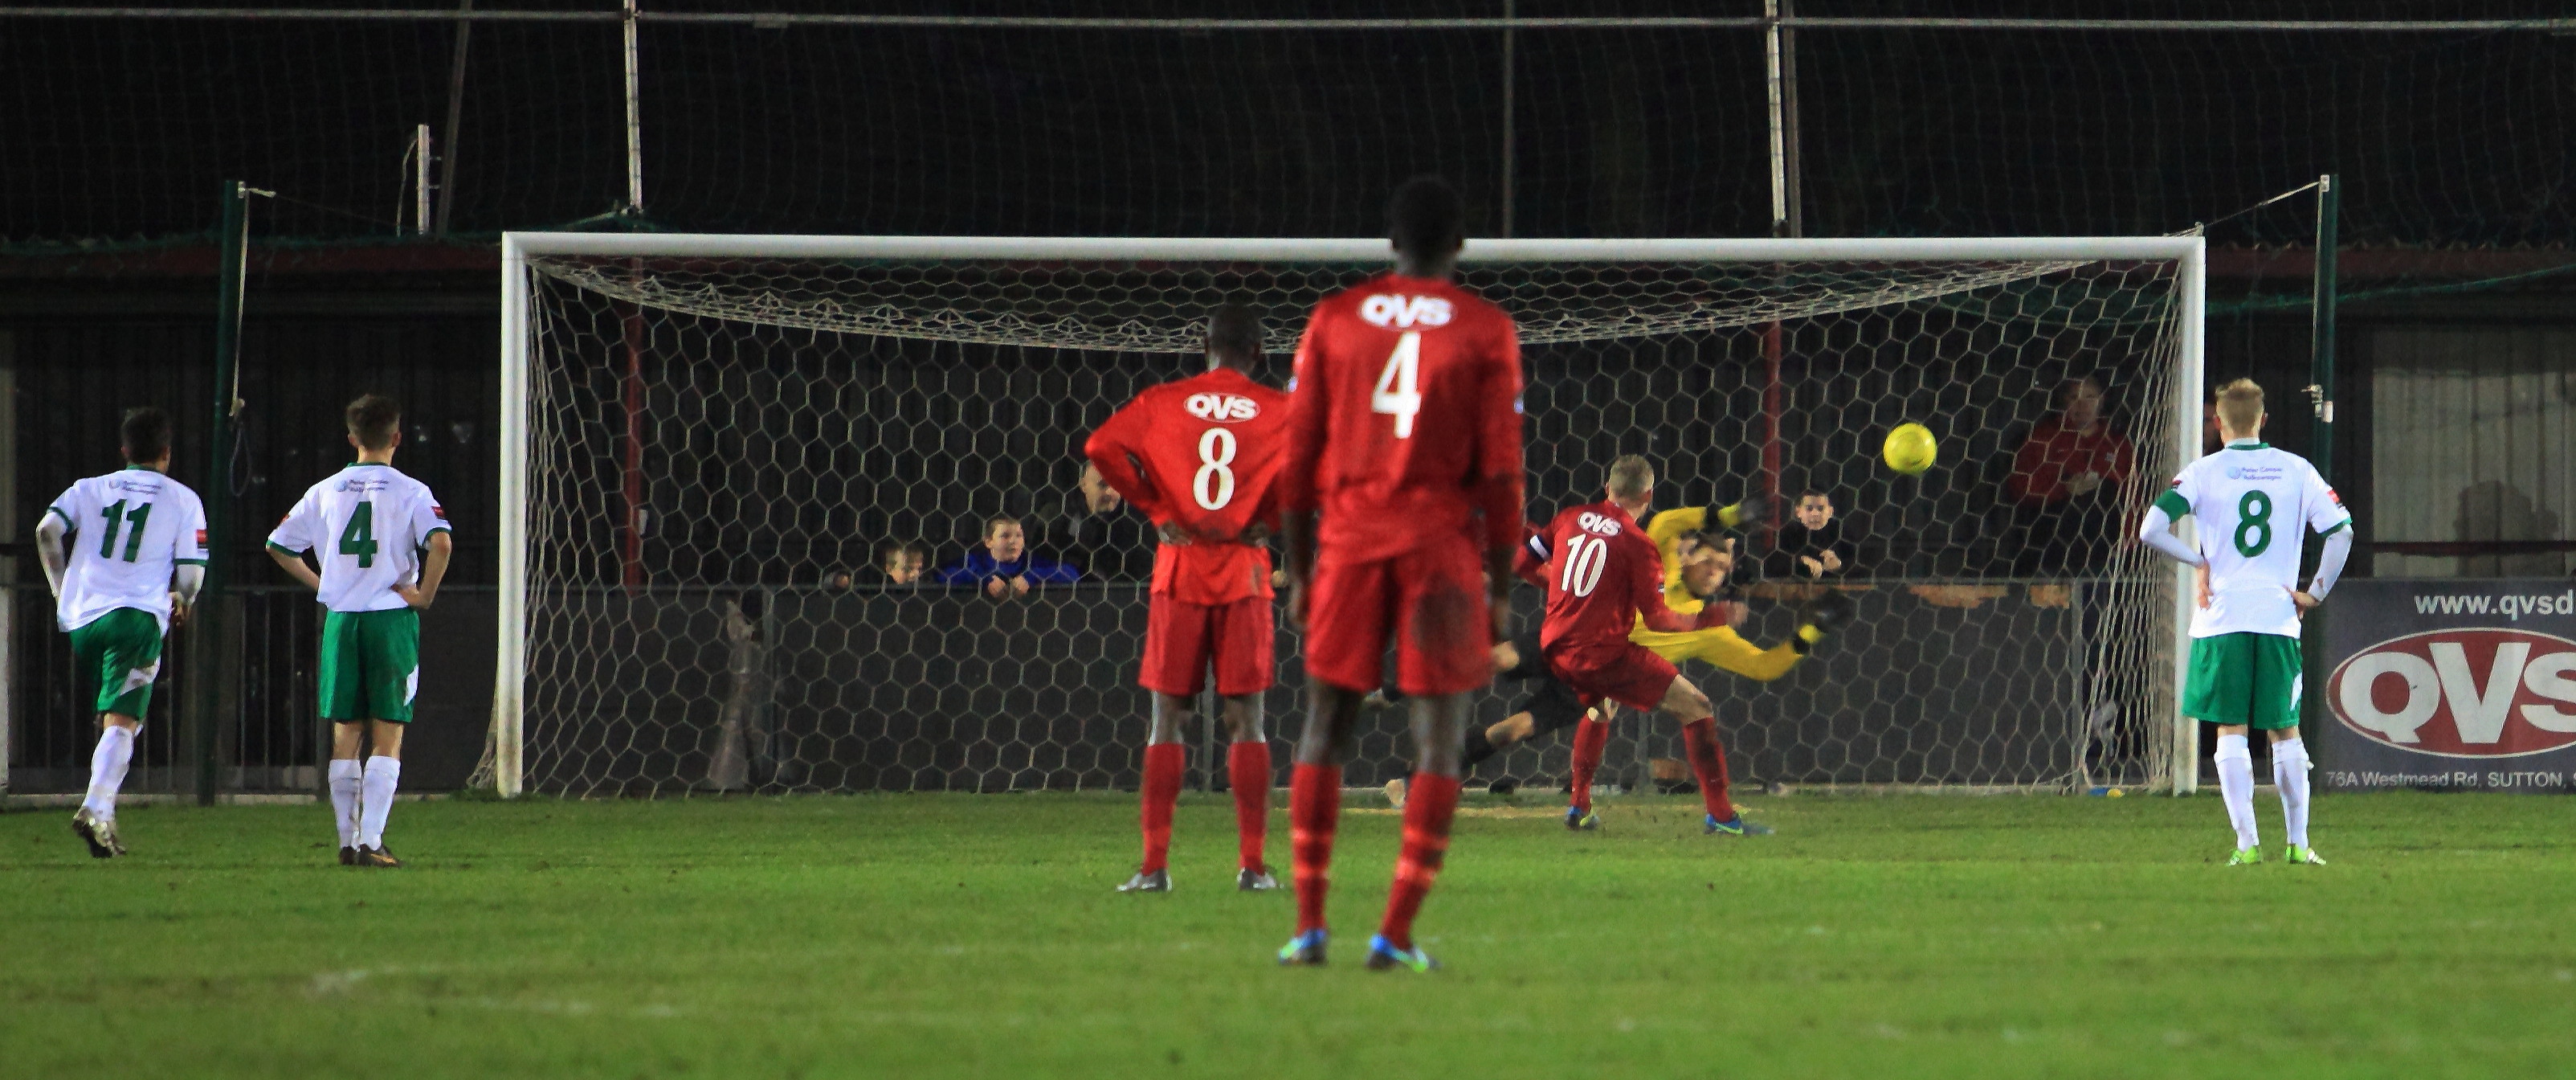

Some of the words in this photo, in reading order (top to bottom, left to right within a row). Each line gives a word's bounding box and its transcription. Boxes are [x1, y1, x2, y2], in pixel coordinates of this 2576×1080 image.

[1361, 293, 1453, 328] QVS
[1186, 393, 1257, 420] QVS
[1371, 331, 1423, 439] 4
[1193, 427, 1237, 510] 8
[100, 498, 152, 562] 11
[339, 501, 378, 568] 4
[1578, 511, 1623, 537] QVS
[2235, 489, 2272, 558] 8
[1561, 534, 1607, 597] 10
[2413, 589, 2574, 621] www.qvsd
[2339, 642, 2576, 744] QVS
[2326, 771, 2358, 787] 76A
[2362, 771, 2449, 788] Westmead
